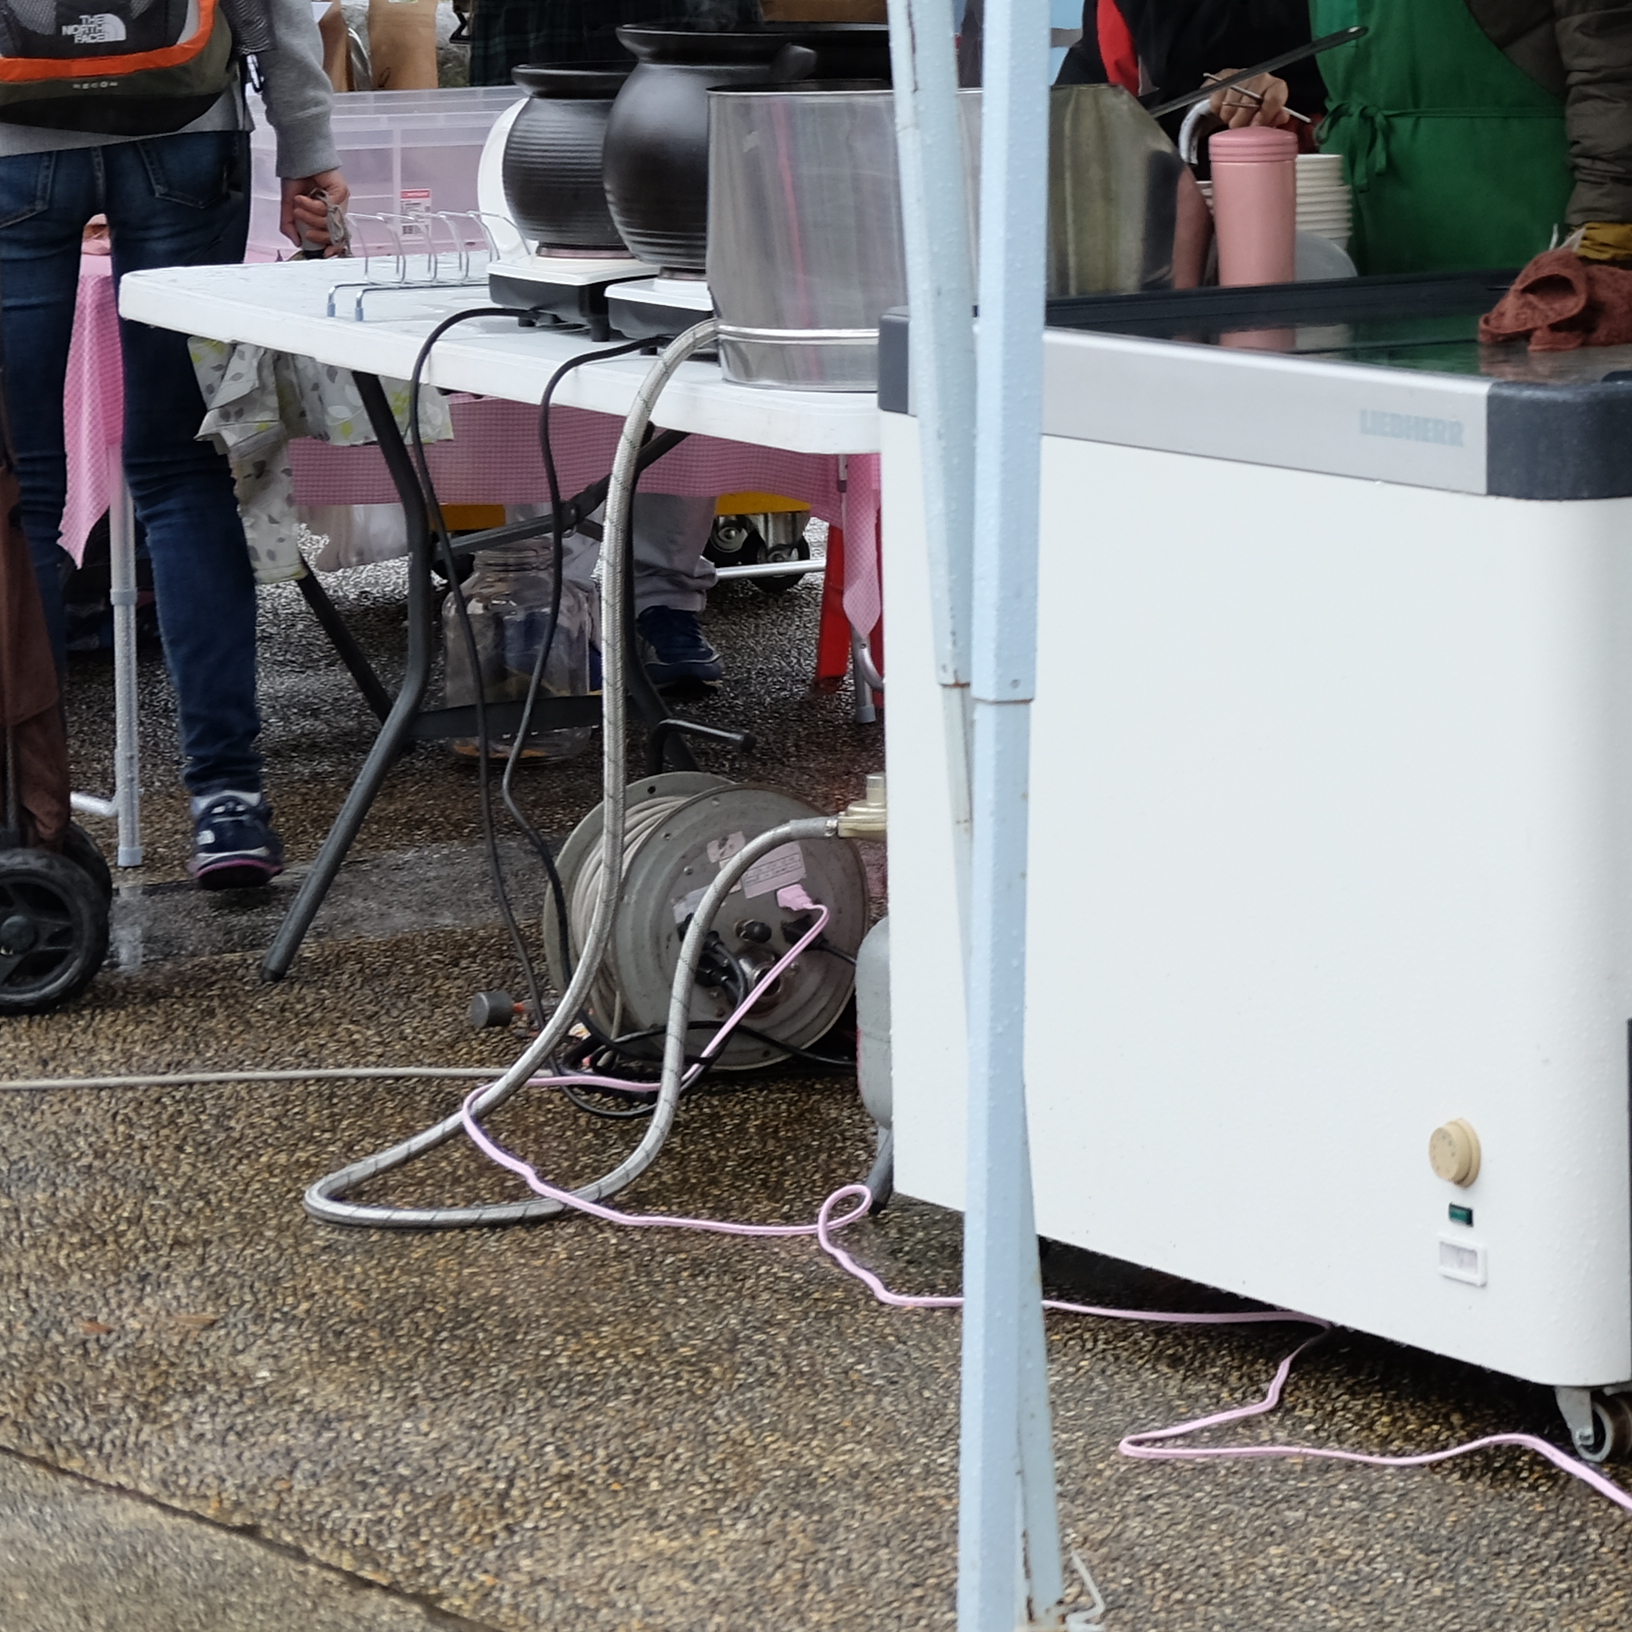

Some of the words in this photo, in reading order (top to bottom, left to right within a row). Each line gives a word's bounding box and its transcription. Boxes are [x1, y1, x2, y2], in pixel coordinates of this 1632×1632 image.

[78, 14, 105, 25] THE
[61, 24, 104, 36] NORTH
[73, 33, 106, 44] FACE
[1359, 407, 1465, 448] LIEBHERR
